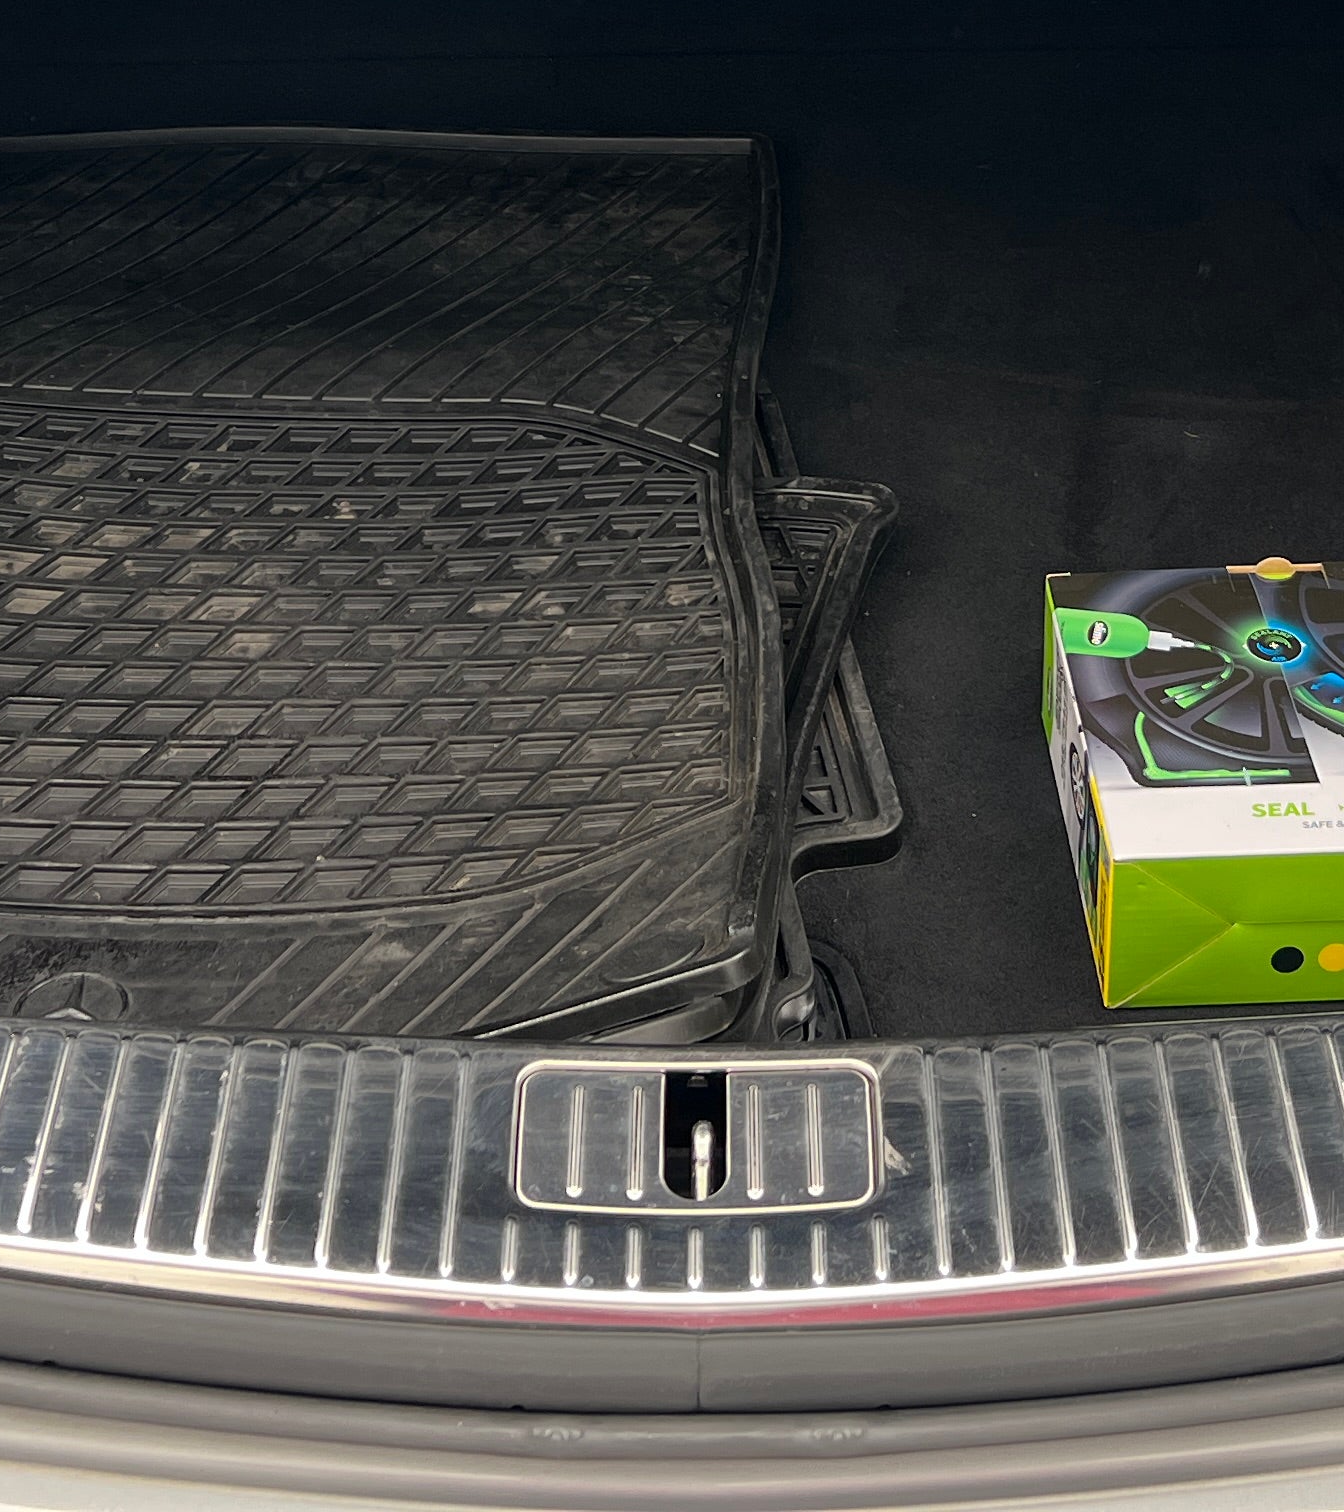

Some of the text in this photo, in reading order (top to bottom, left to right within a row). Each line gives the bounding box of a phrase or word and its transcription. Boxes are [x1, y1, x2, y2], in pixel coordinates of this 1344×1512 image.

[1251, 802, 1316, 817] SEAL
[1302, 820, 1334, 829] SAFE
[1336, 820, 1344, 828] &
